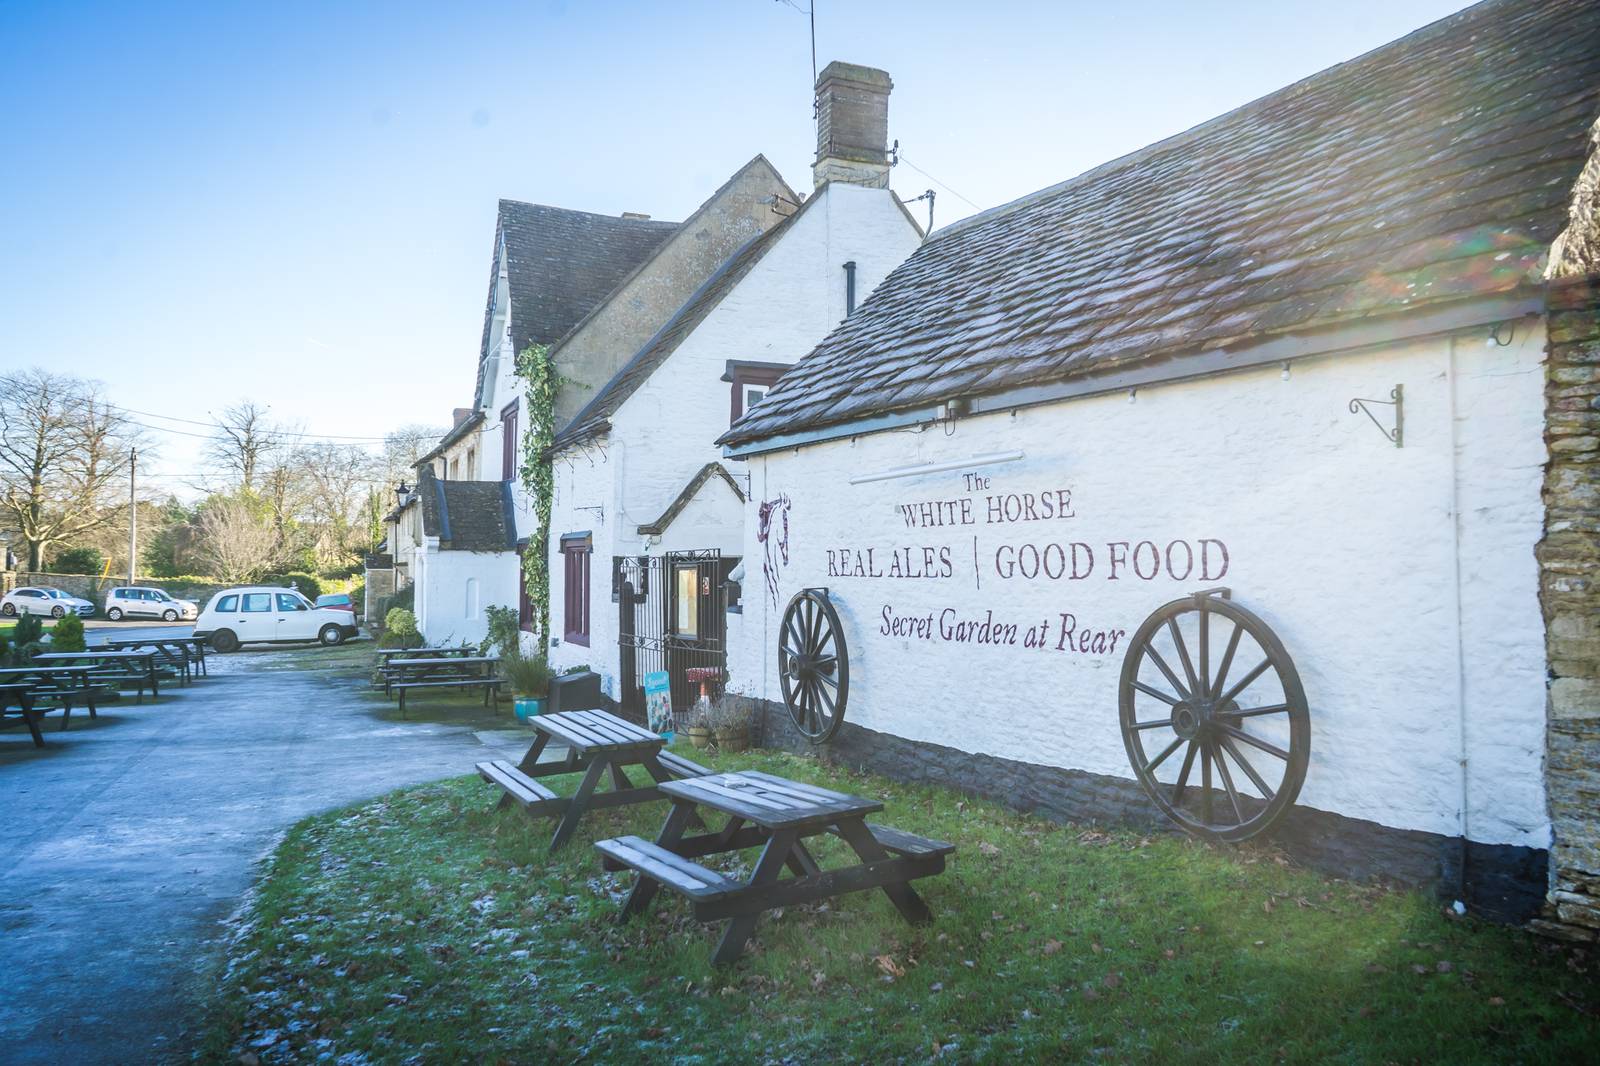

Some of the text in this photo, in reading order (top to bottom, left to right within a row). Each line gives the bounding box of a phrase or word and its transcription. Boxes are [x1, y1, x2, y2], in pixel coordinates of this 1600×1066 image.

[962, 472, 991, 492] The
[901, 489, 1076, 528] WHITE HORSE
[826, 546, 953, 578] REAL ALES
[995, 538, 1230, 581] GOOD FOOD
[880, 604, 1126, 655] Secret Garden at Rear
